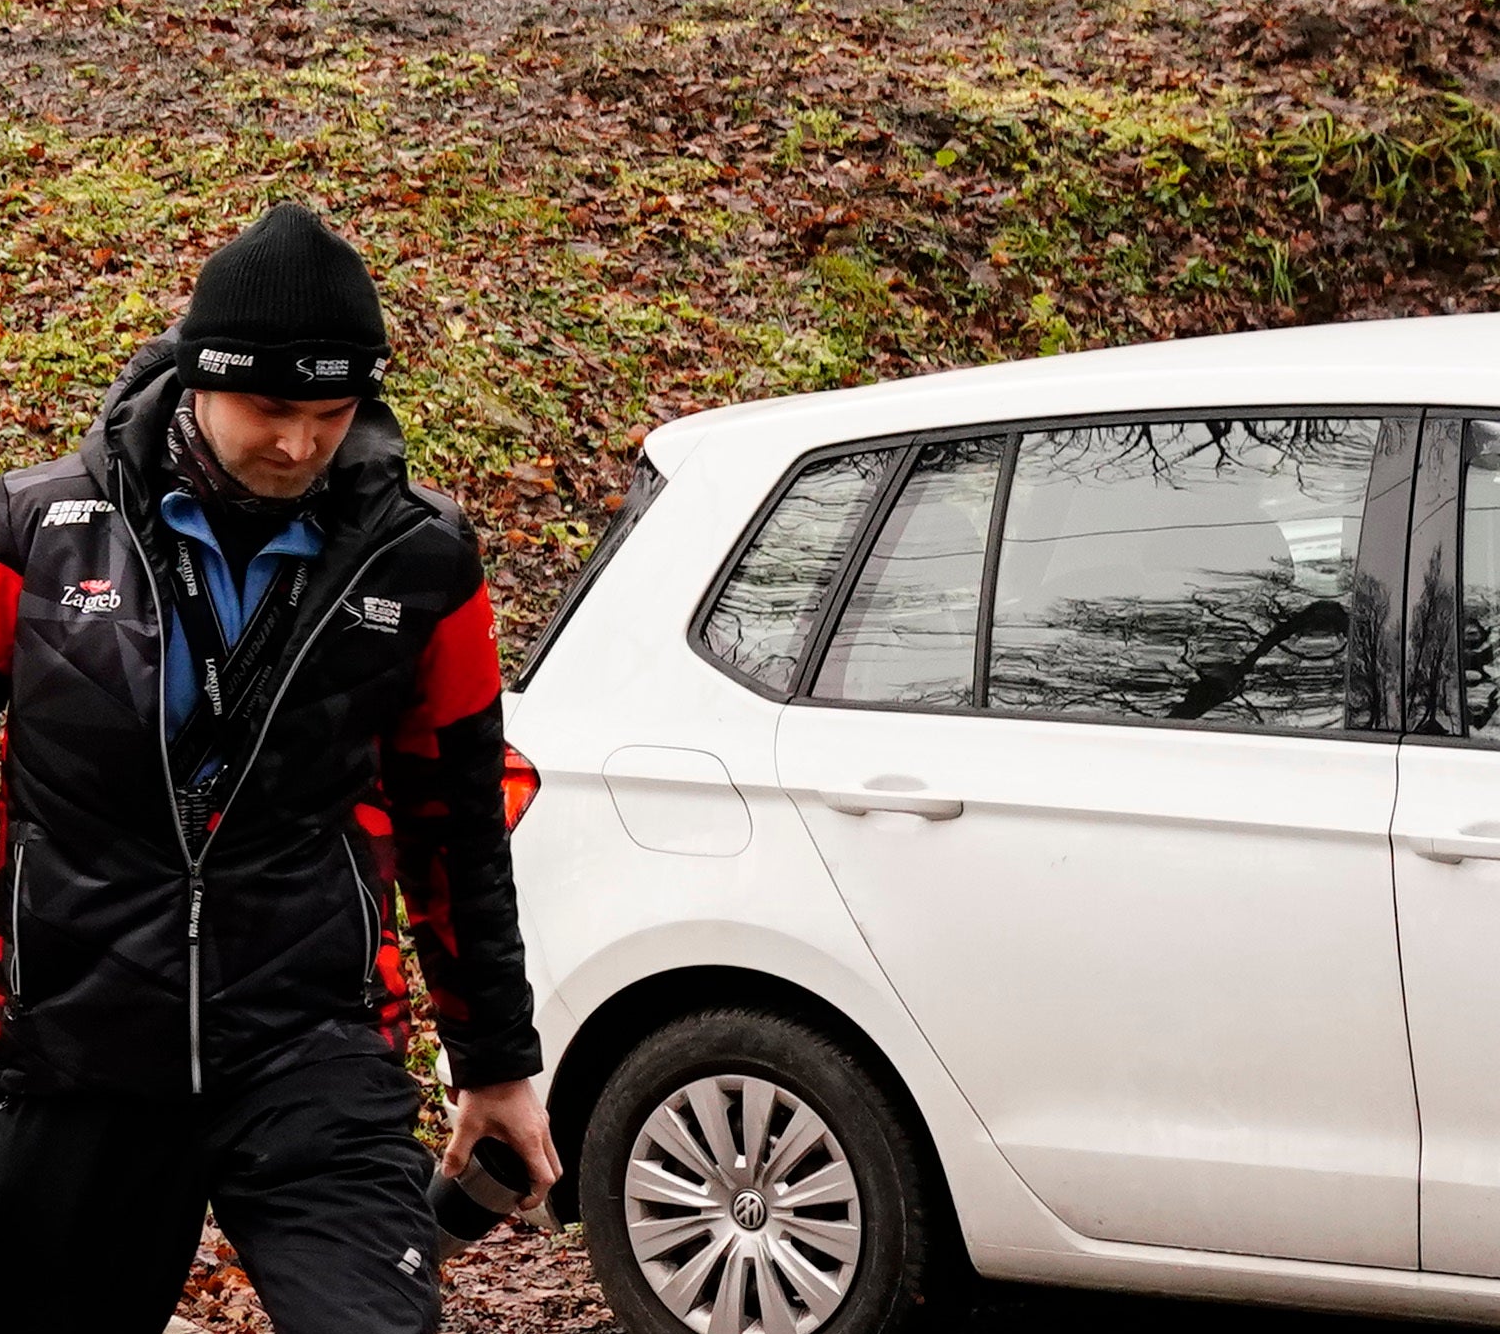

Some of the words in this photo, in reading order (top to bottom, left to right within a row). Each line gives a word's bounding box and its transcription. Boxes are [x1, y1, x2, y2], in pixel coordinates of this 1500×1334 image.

[199, 348, 255, 367] ENERGIA
[198, 359, 227, 375] PURA
[41, 512, 91, 527] PURA
